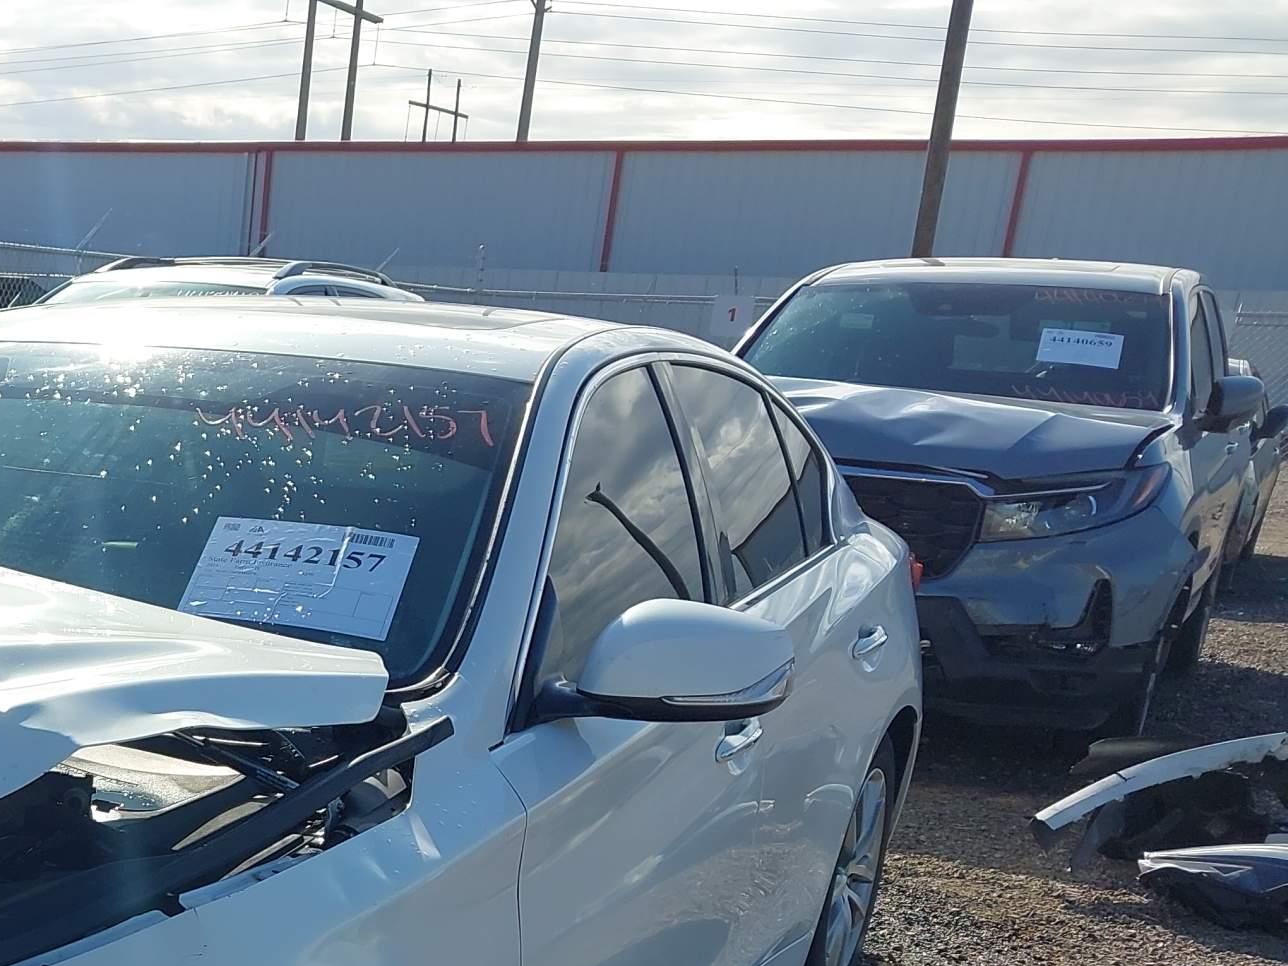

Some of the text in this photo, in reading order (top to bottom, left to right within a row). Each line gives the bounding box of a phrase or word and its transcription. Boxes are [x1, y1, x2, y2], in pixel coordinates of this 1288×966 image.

[728, 308, 736, 321] 1
[1049, 335, 1113, 348] 44140659
[196, 403, 495, 447] 44142157
[224, 539, 387, 572] 44142157
